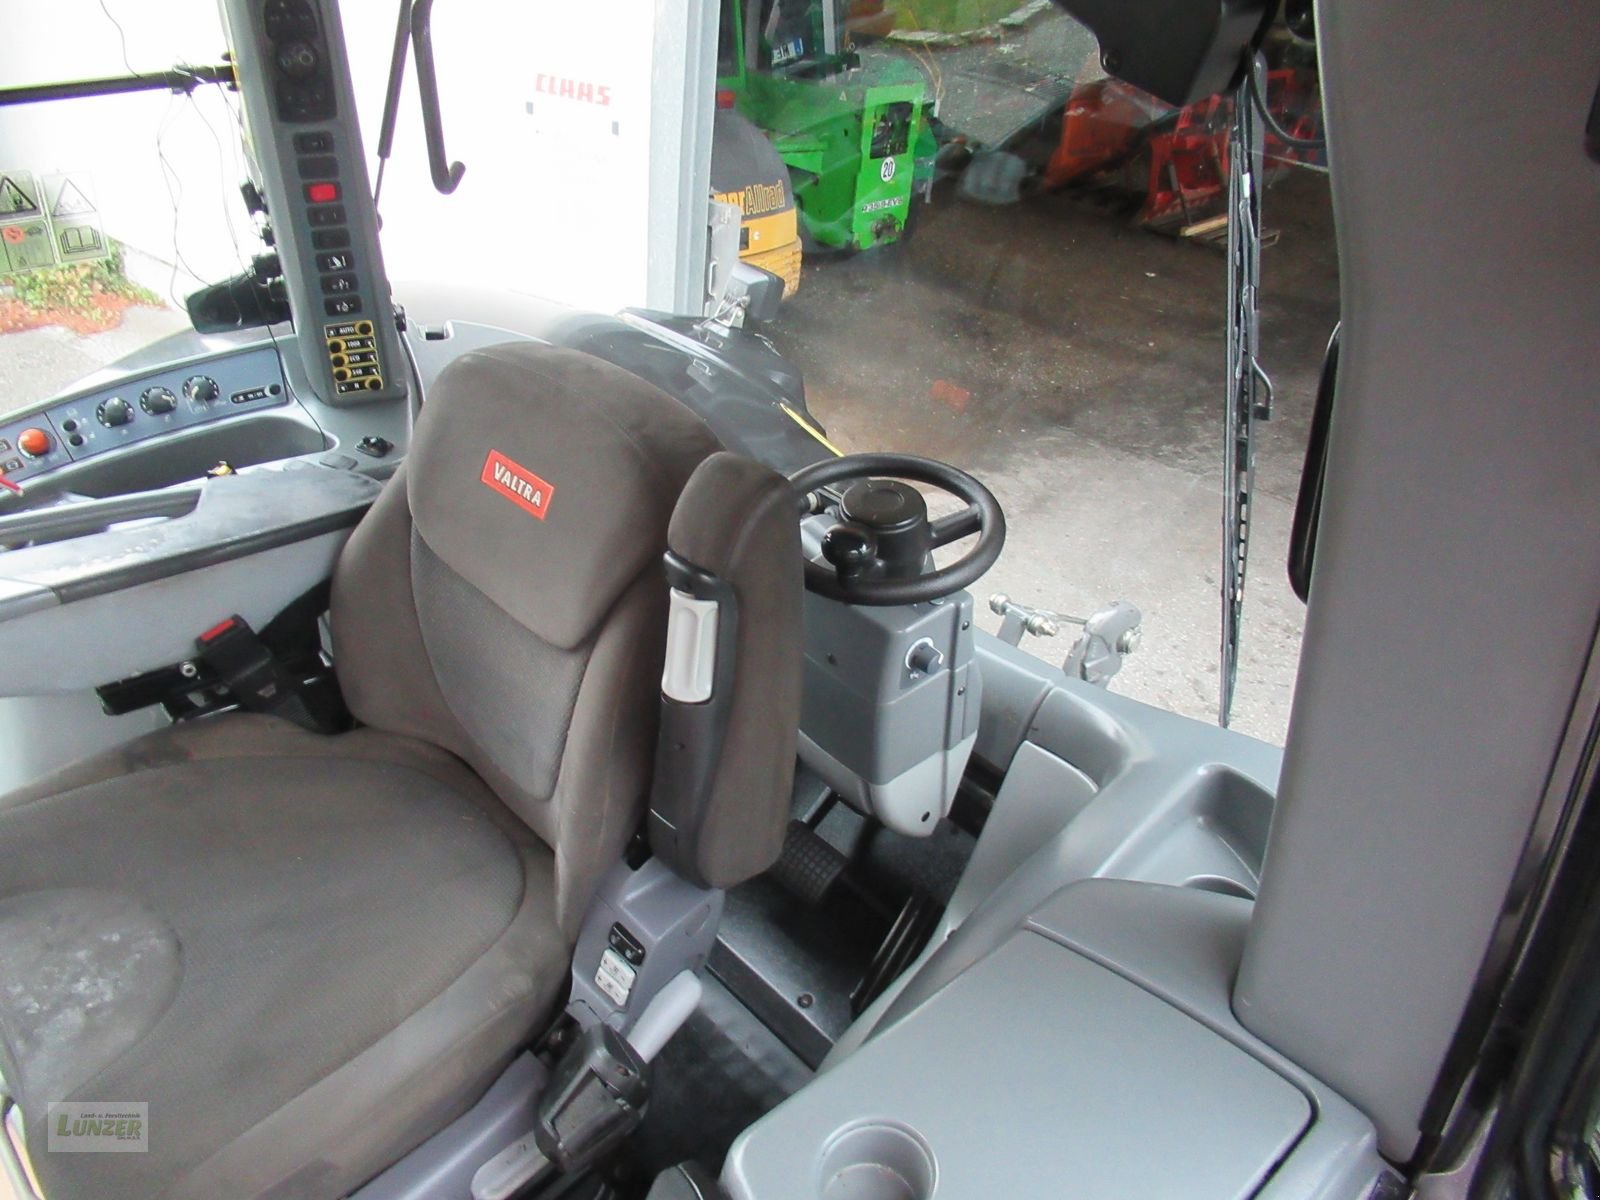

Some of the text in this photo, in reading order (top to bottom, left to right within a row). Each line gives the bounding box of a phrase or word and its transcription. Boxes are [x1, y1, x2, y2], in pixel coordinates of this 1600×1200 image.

[535, 73, 611, 106] CLAAS
[882, 161, 894, 179] 20
[745, 179, 785, 216] Allrad
[339, 326, 355, 335] AUTO
[494, 462, 542, 506] VALTRA
